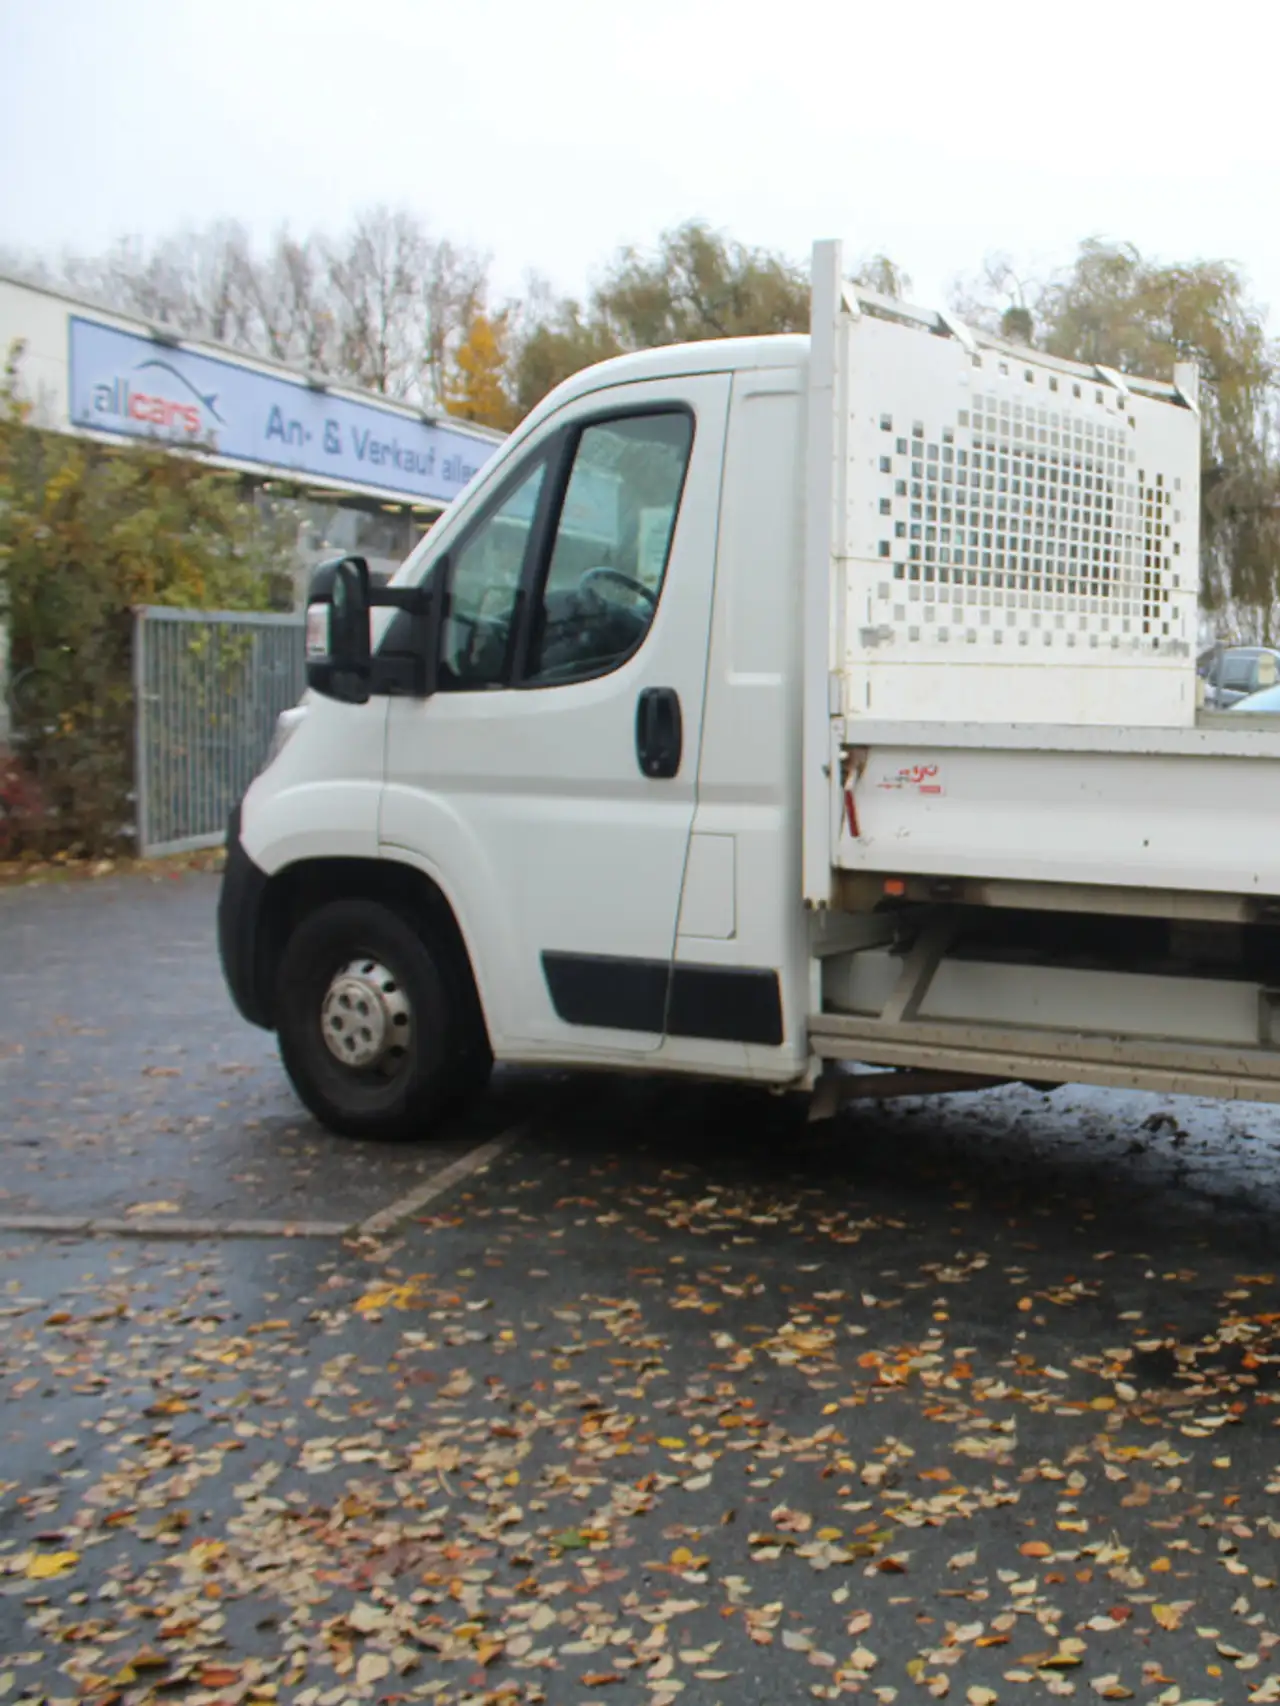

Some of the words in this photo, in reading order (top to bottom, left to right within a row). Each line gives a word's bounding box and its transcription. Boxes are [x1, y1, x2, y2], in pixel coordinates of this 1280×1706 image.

[93, 376, 201, 432] allcars
[265, 404, 311, 446] An-
[323, 419, 342, 454] &
[352, 425, 435, 477] Verkauf
